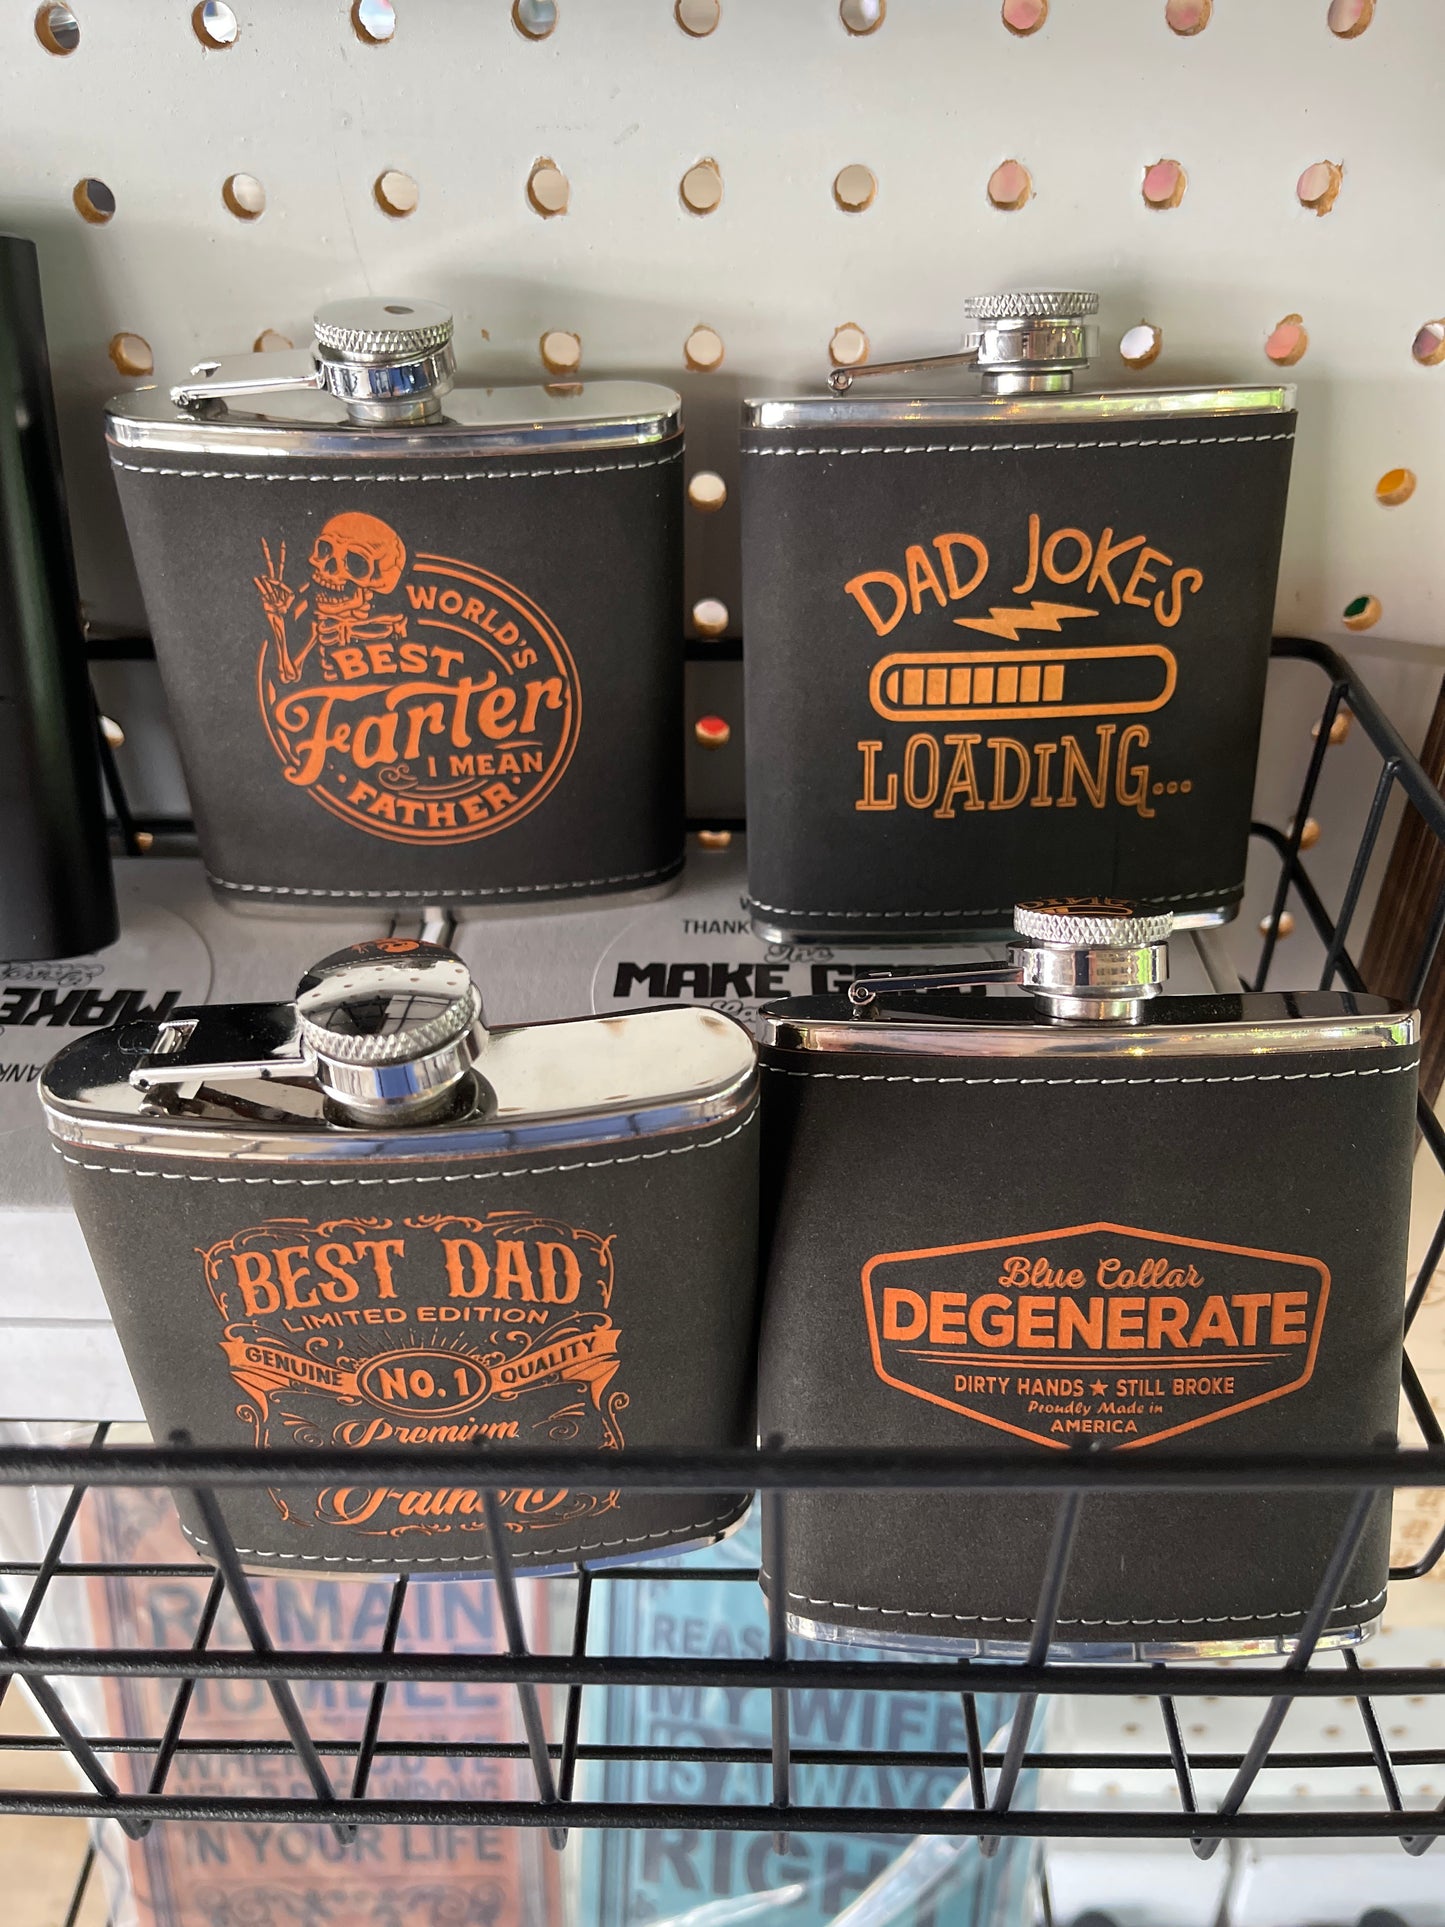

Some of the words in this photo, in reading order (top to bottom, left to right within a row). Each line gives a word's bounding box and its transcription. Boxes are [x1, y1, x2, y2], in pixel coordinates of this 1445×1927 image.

[844, 532, 990, 637] DAD
[1011, 513, 1204, 628] JOKES
[405, 584, 539, 670] WORLD'S
[331, 643, 466, 680] BEST
[275, 669, 565, 786] Farter
[427, 755, 437, 778] I
[450, 751, 544, 777] MEAN
[855, 723, 1193, 819] LOADING...
[346, 780, 520, 828] FATHER
[612, 962, 792, 1000] MAKE
[230, 1238, 406, 1317] BEST
[440, 1238, 584, 1305] DAD
[998, 1255, 1087, 1290] Blue
[1095, 1257, 1205, 1290] Collar
[281, 1307, 408, 1333] LIMITED
[416, 1306, 550, 1326] EDITION
[882, 1286, 1310, 1351] DEGENERATE
[244, 1345, 345, 1388] GENUINE
[500, 1335, 598, 1385] QUALITY
[953, 1374, 1009, 1394] DIRTY
[1016, 1377, 1085, 1398] HANDS
[1115, 1378, 1166, 1397] STILL
[1172, 1375, 1236, 1395] BROKE
[1027, 1399, 1092, 1418] Proudly
[1097, 1401, 1146, 1415] Made
[1148, 1400, 1164, 1415] in
[1049, 1418, 1139, 1434] AMERICA
[332, 1416, 520, 1449] Premium
[402, 1822, 504, 1864] LIFE
